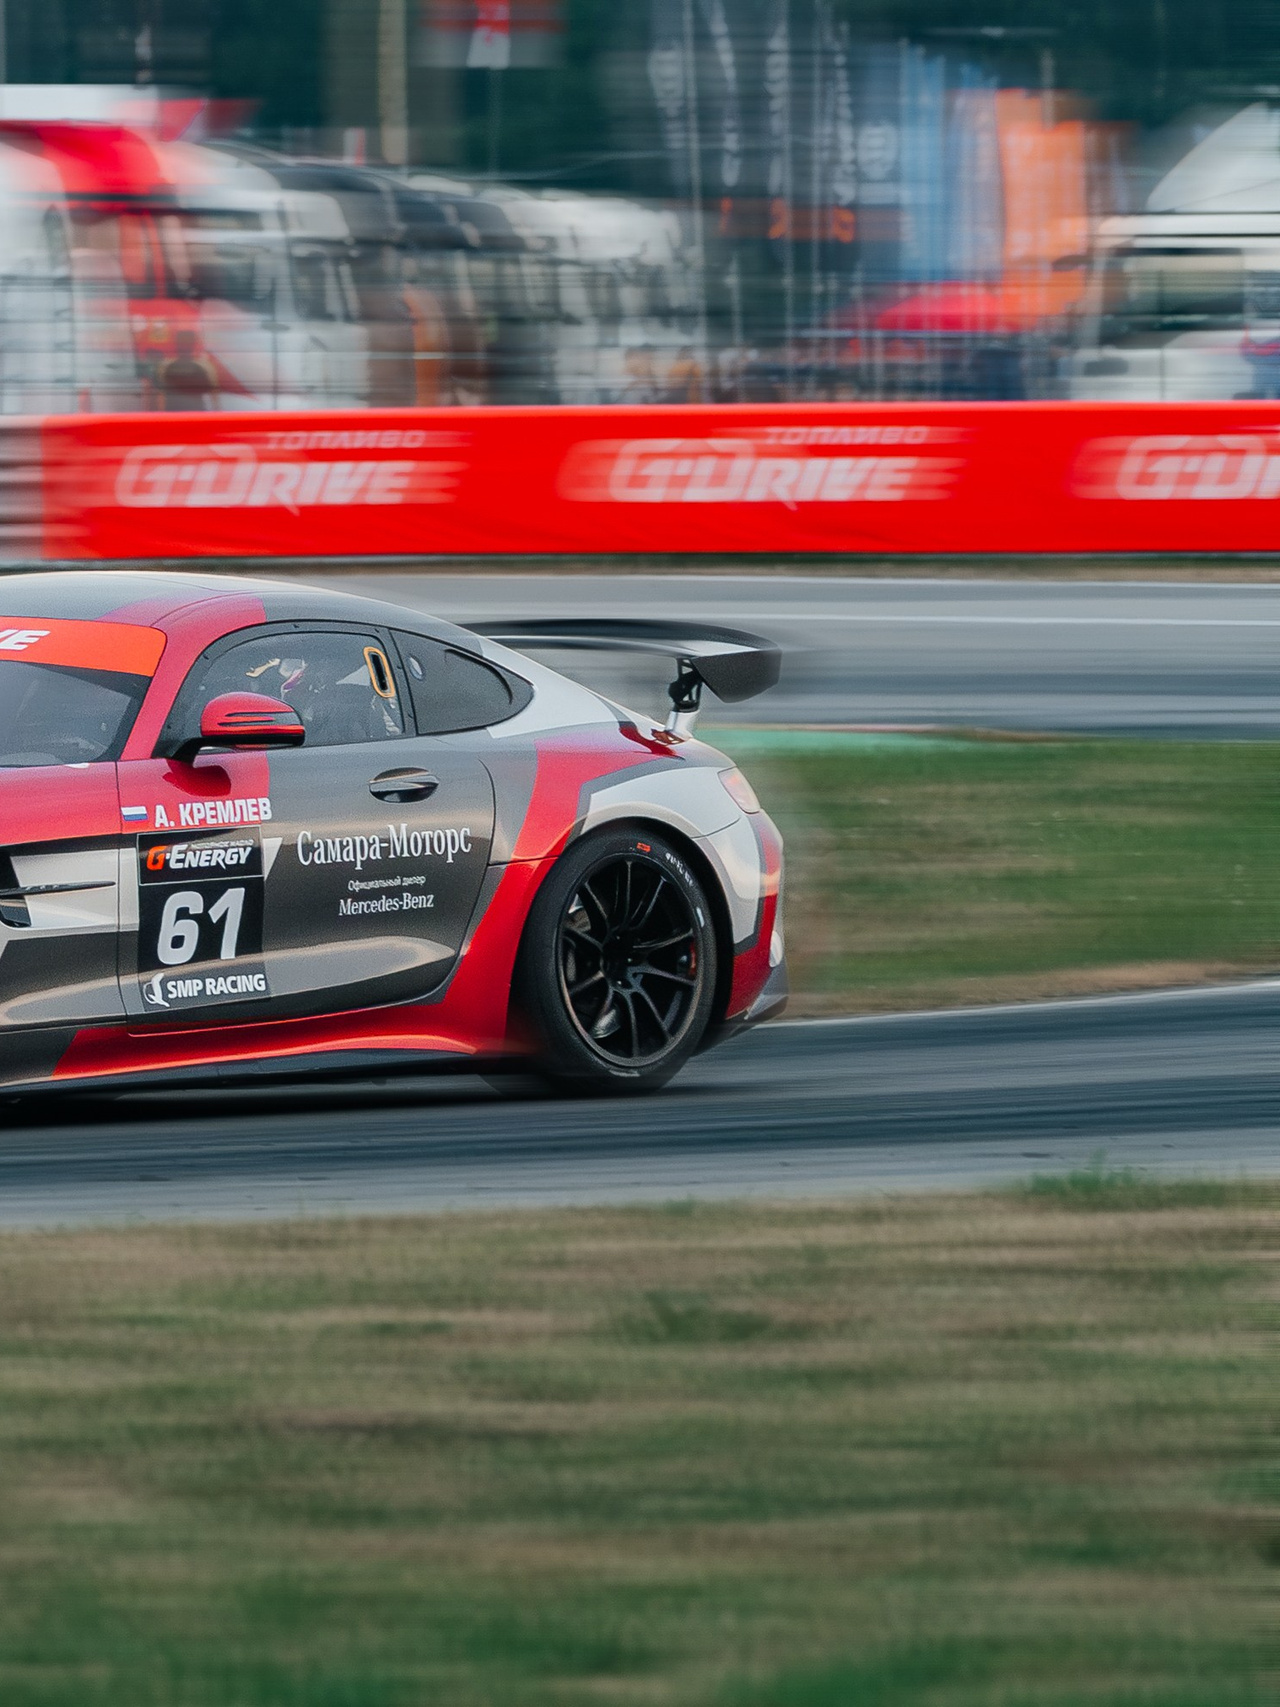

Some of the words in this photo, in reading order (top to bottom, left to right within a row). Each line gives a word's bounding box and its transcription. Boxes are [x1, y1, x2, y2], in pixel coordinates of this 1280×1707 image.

[154, 804, 176, 828] А.
[178, 797, 272, 826] КРЕМЛЕВ
[297, 823, 472, 870] Самара-Моторс
[338, 892, 434, 916] Mercedes-Benz
[157, 887, 246, 966] 61
[166, 979, 203, 999] SMP
[205, 974, 266, 995] RACING
